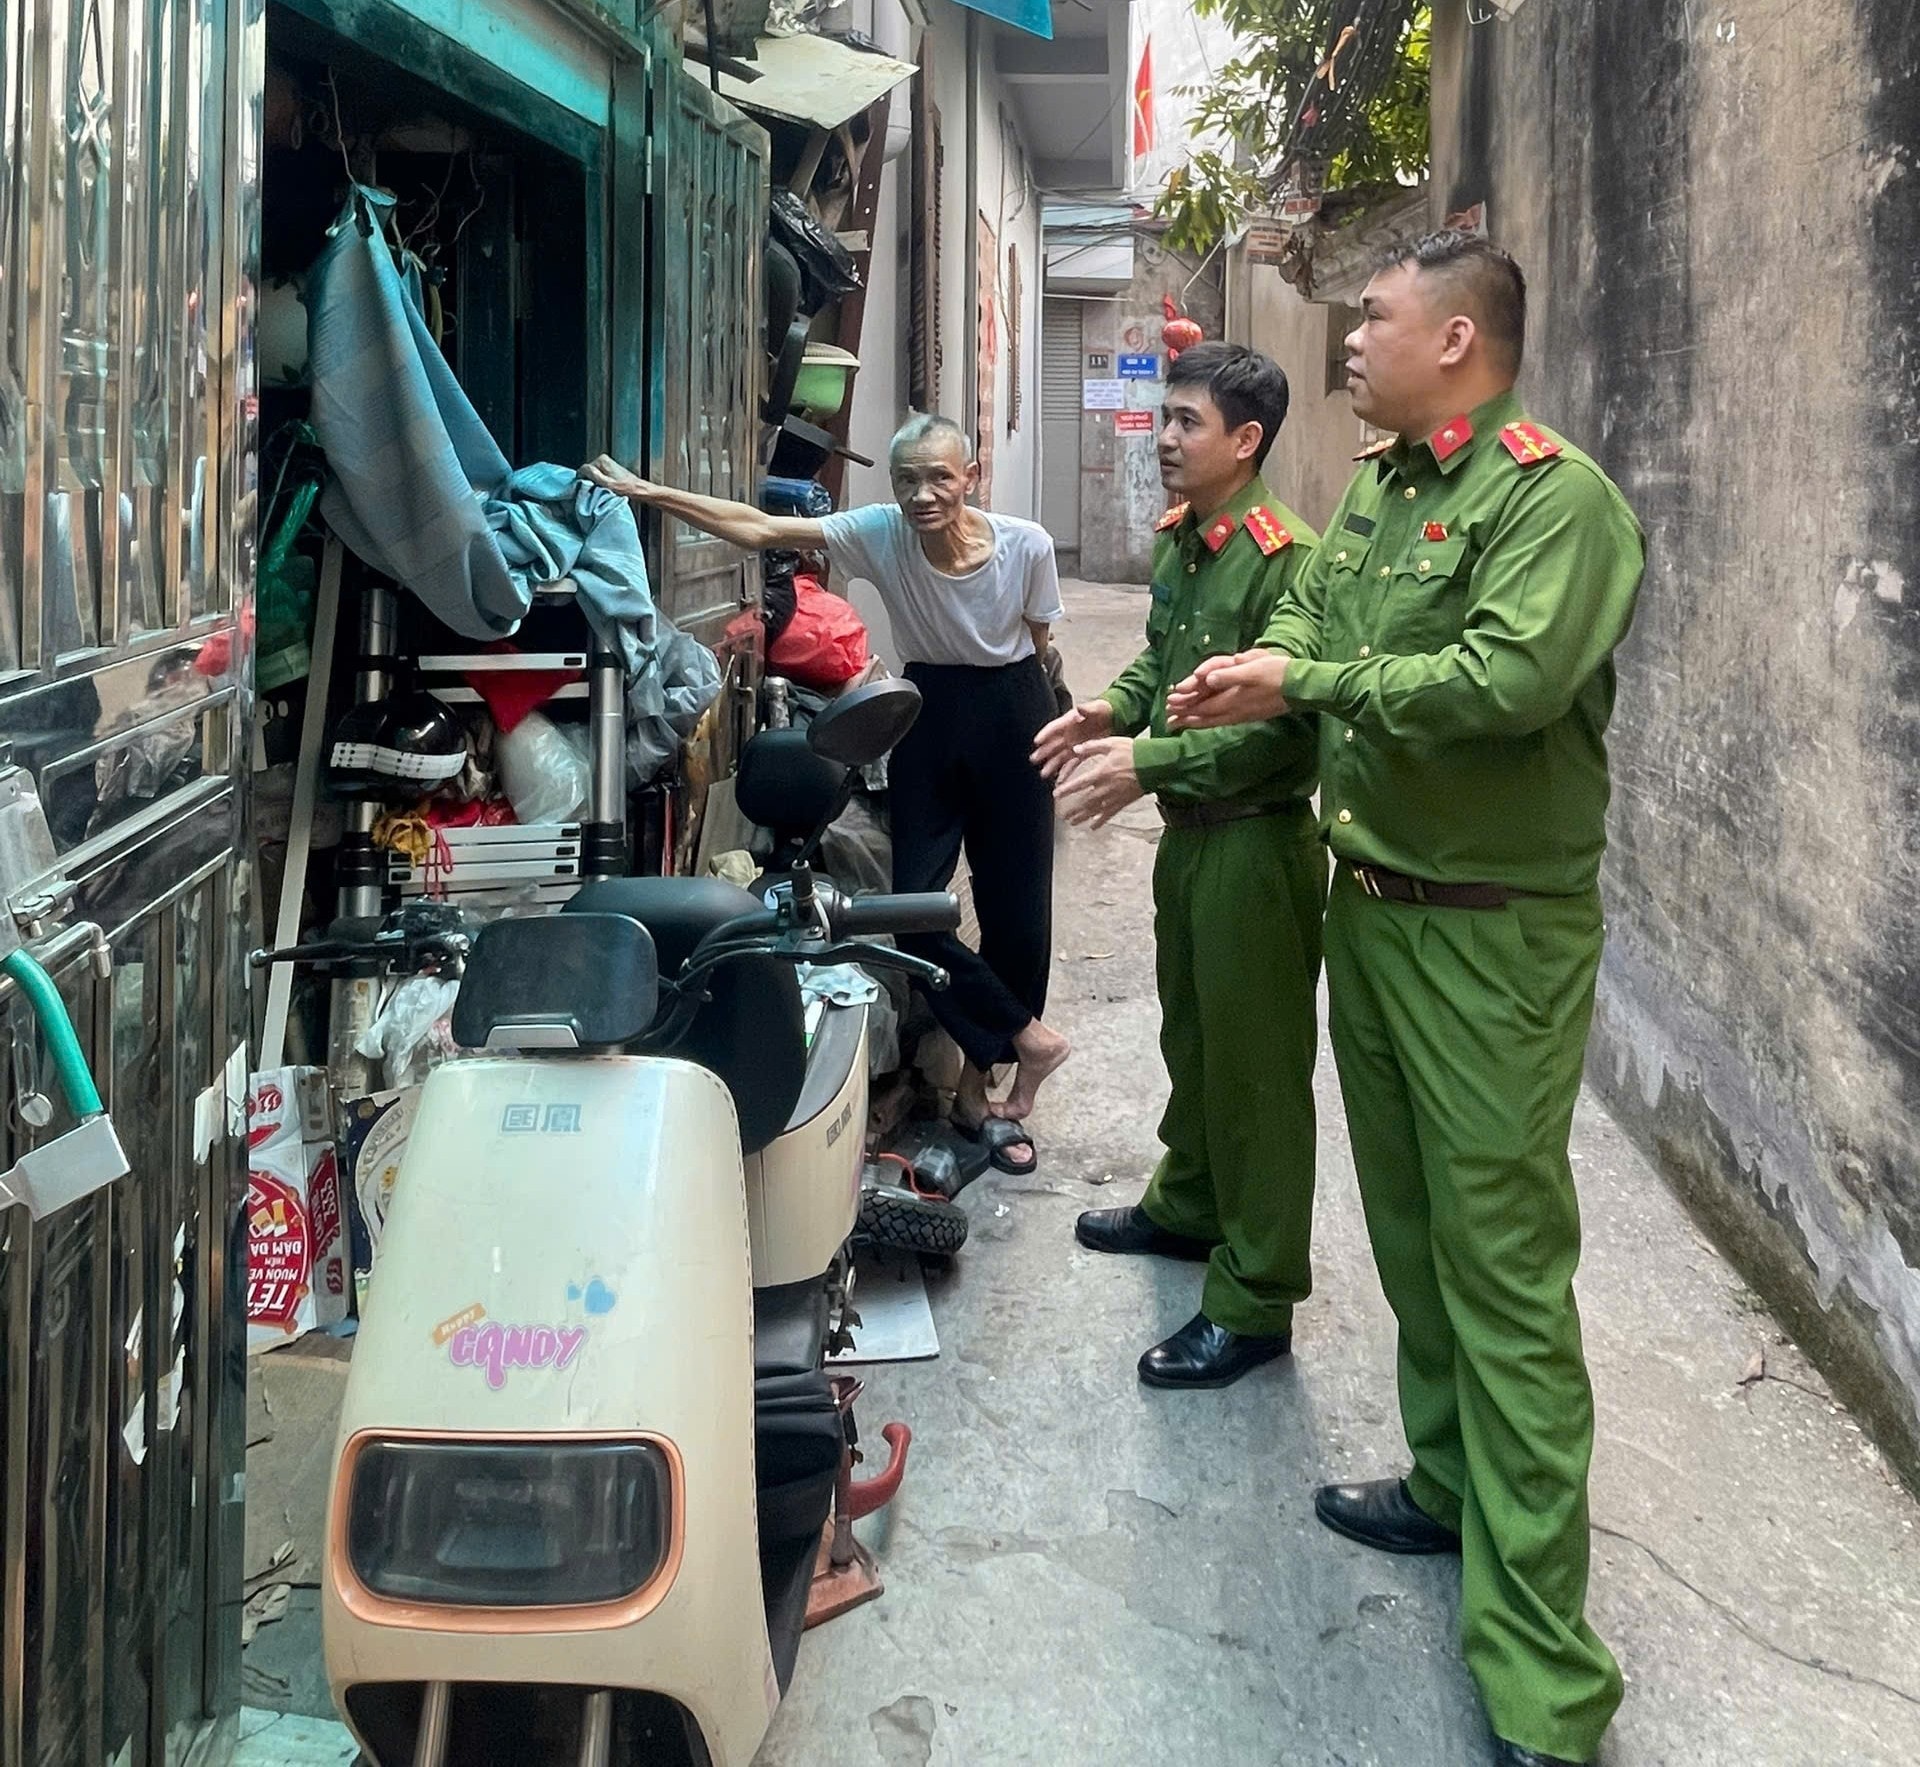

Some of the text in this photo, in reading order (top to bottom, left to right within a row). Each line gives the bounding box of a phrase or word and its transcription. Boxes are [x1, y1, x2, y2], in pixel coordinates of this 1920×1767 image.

[321, 1177, 337, 1222] 333
[264, 1257, 286, 1268] THÊM
[265, 1268, 298, 1283] MUÔN
[450, 1321, 588, 1390] CANDY
